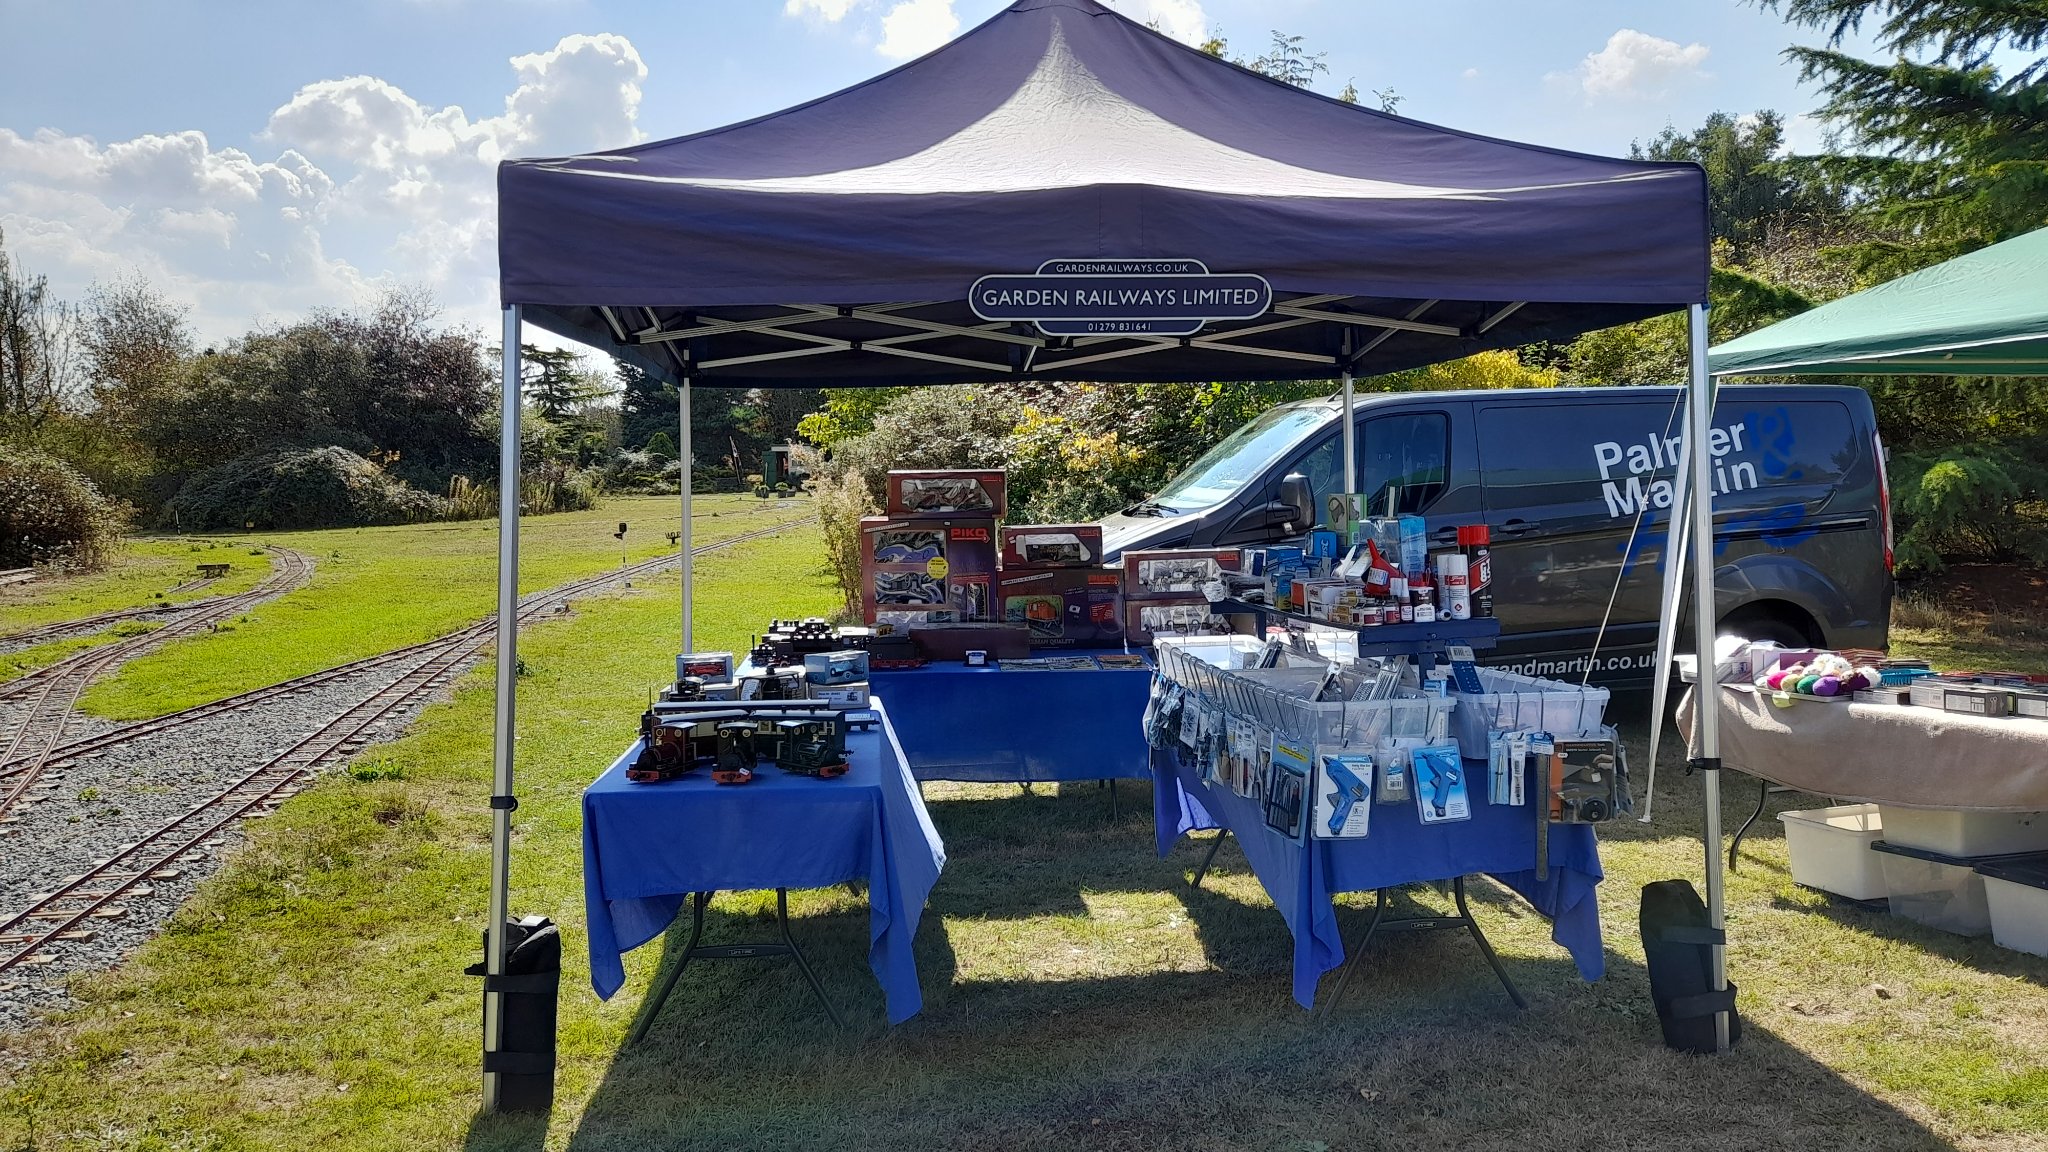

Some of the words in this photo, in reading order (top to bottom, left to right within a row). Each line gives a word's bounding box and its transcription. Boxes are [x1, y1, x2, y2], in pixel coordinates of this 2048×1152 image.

[1056, 263, 1189, 273] GARDENRAILWAYS.CO.UK
[983, 288, 1068, 306] GARDEN
[1075, 288, 1176, 306] RAILWAYS
[1183, 288, 1258, 305] LIMITED
[1088, 322, 1115, 332] 01279
[1119, 322, 1151, 332] 831641
[1602, 459, 1759, 518] Main
[950, 528, 988, 539] PIKO
